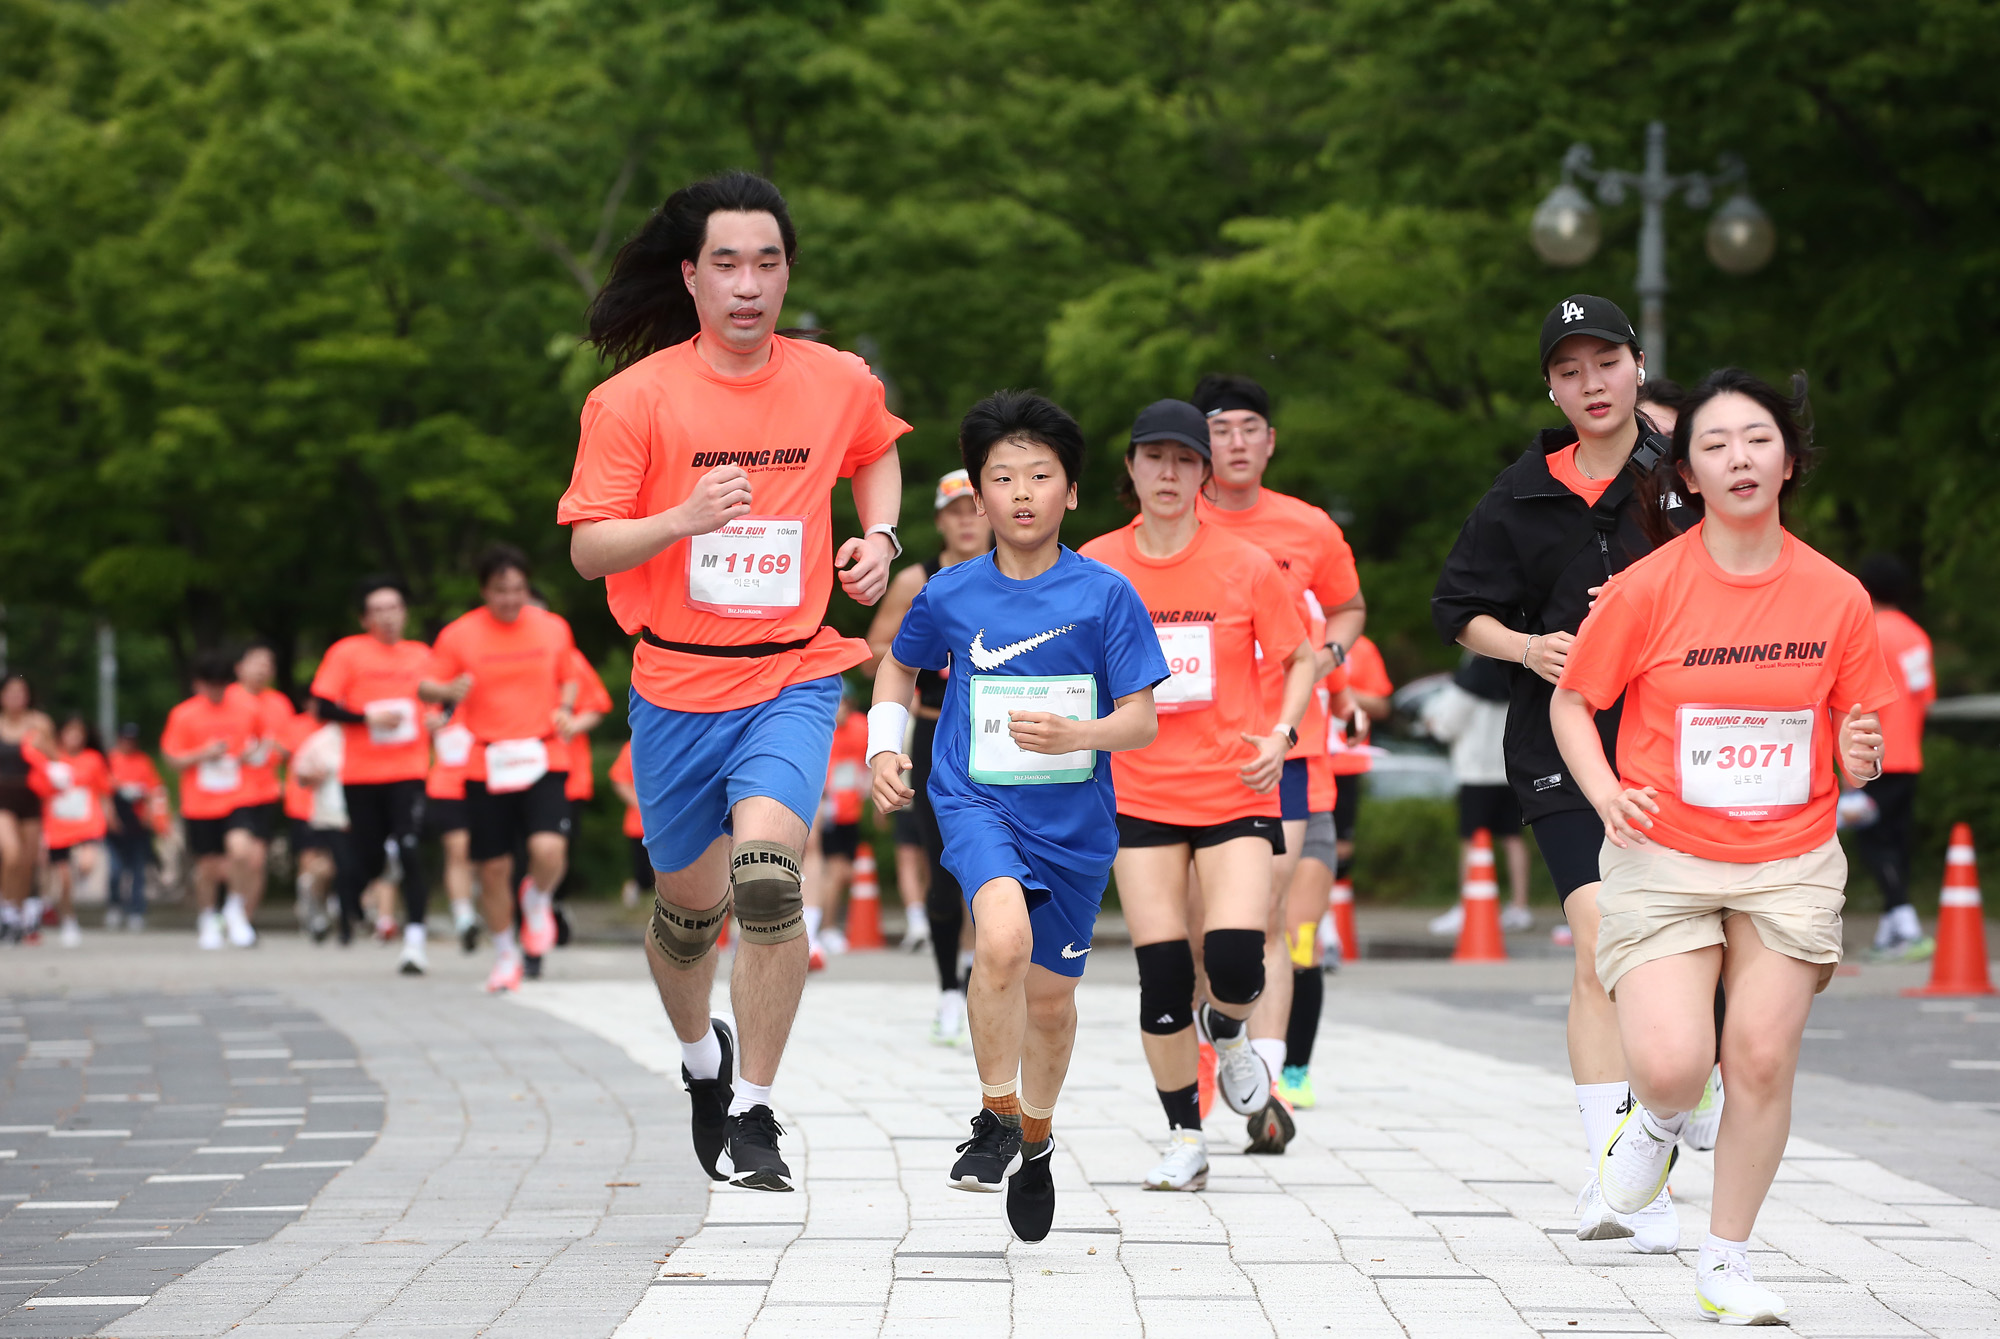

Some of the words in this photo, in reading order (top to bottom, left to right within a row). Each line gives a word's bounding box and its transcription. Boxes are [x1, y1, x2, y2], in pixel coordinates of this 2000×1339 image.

[1561, 300, 1585, 324] LA
[691, 450, 771, 467] BURNING
[771, 448, 811, 464] RUN
[745, 526, 767, 535] RUN
[776, 528, 798, 536] 10km
[700, 554, 719, 568] M
[725, 553, 791, 574] 1169
[1182, 611, 1217, 622] RUN
[1682, 643, 1782, 667] BURNING
[1784, 641, 1827, 660] RUN
[981, 686, 1025, 696] BURNING
[1027, 686, 1050, 696] RUN
[984, 719, 1001, 733] M
[1690, 716, 1741, 726] BURNING
[1742, 716, 1768, 726] RUN
[1691, 750, 1712, 766] W
[1716, 743, 1794, 769] 3071
[1733, 774, 1763, 785] 김도연
[745, 925, 769, 933] MADE
